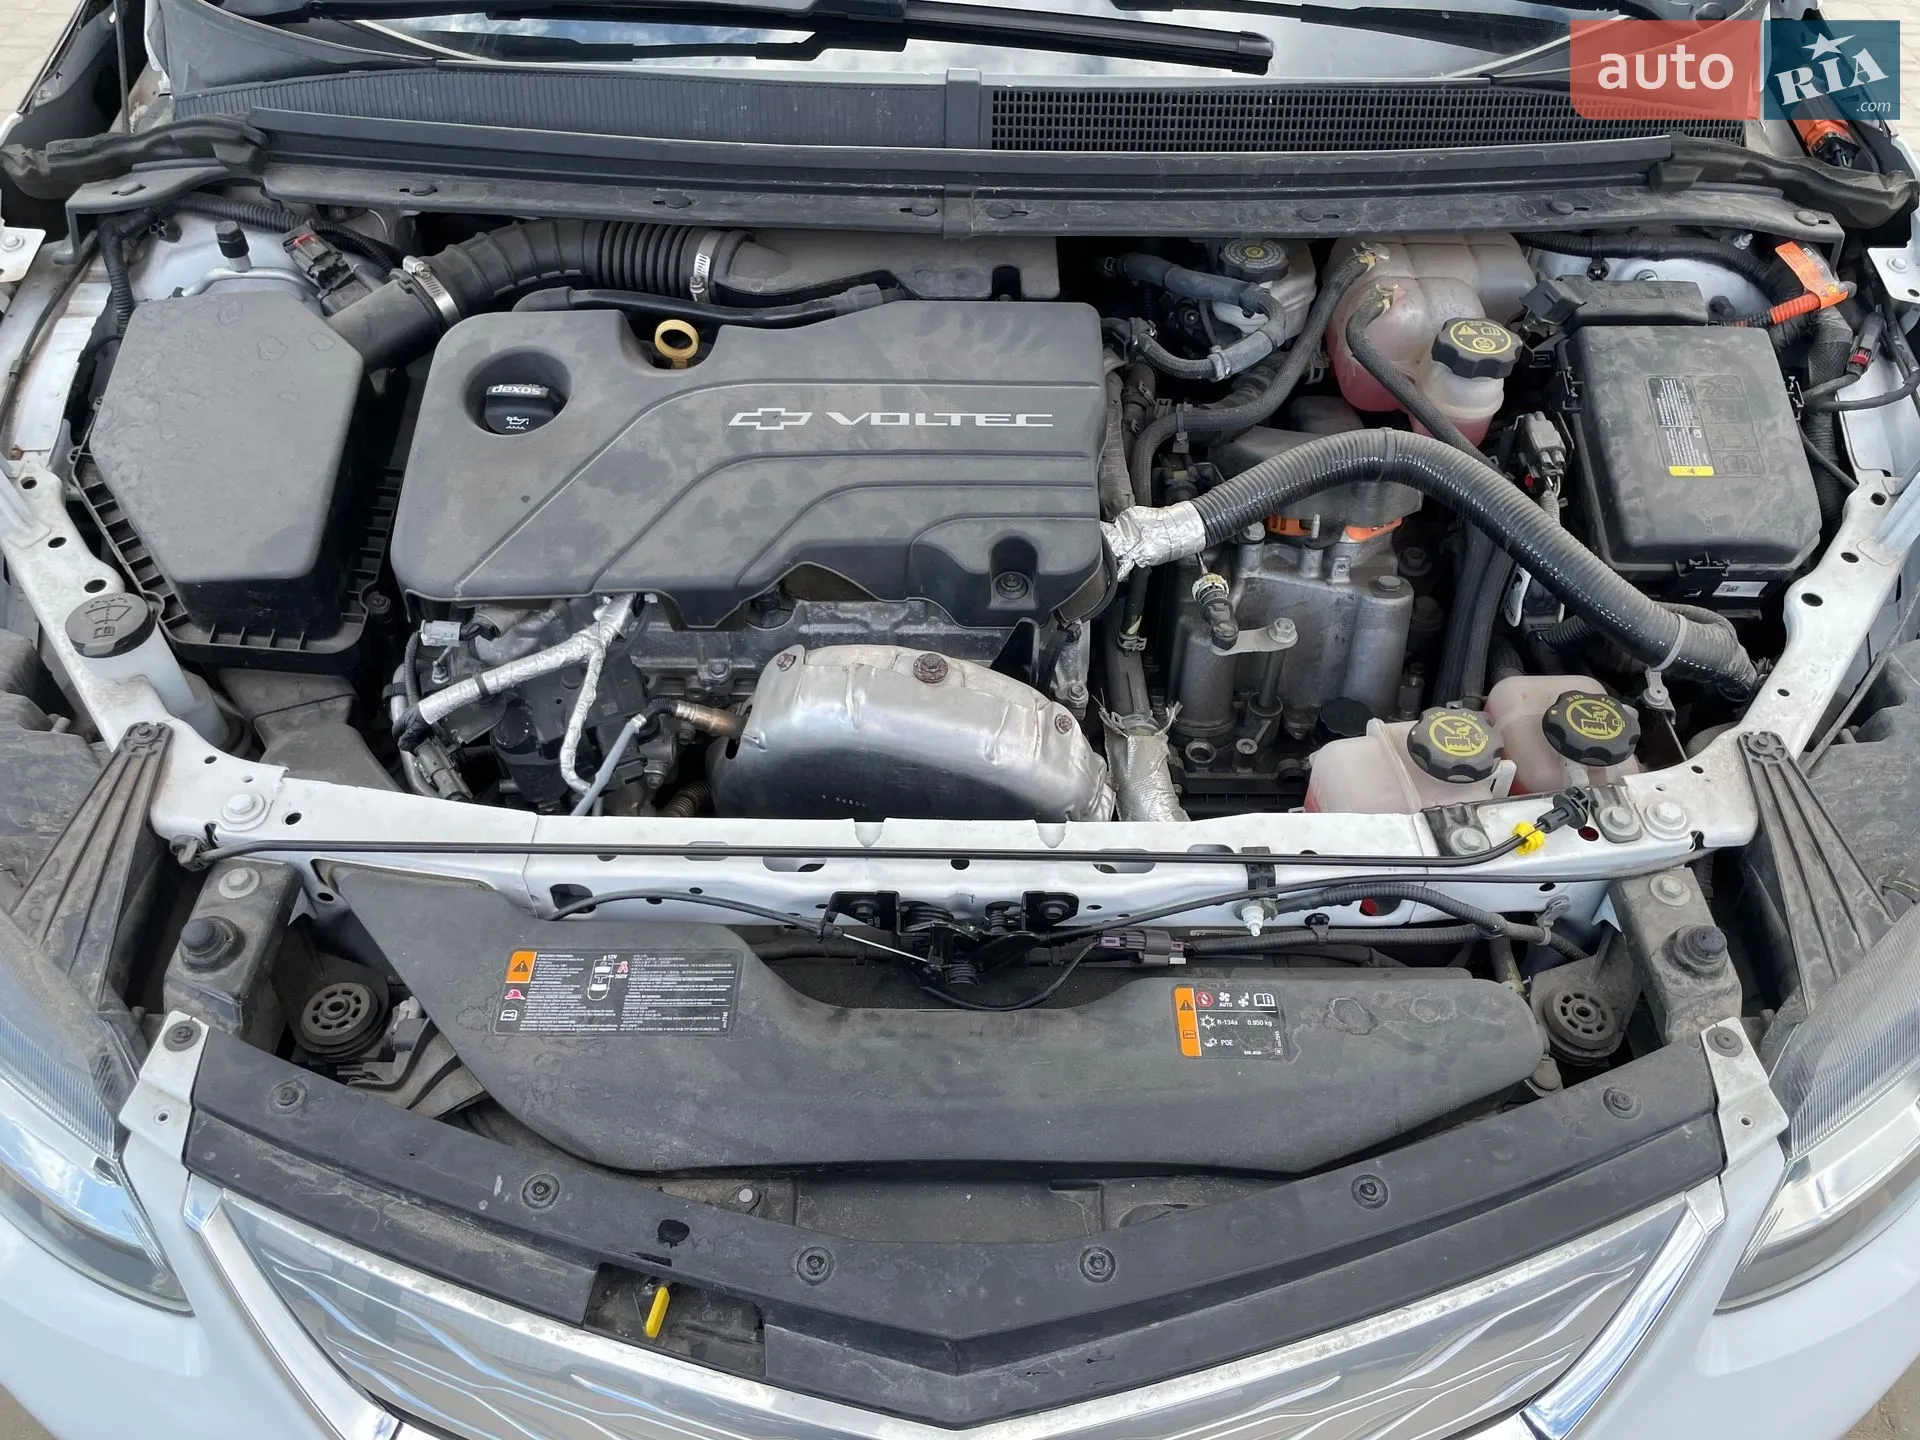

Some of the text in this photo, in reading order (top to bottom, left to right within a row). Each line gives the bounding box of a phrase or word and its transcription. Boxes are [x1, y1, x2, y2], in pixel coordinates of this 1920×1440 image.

[491, 384, 541, 395] dexos
[826, 412, 1054, 427] VOLTEC
[1264, 1019, 1273, 1028] kg
